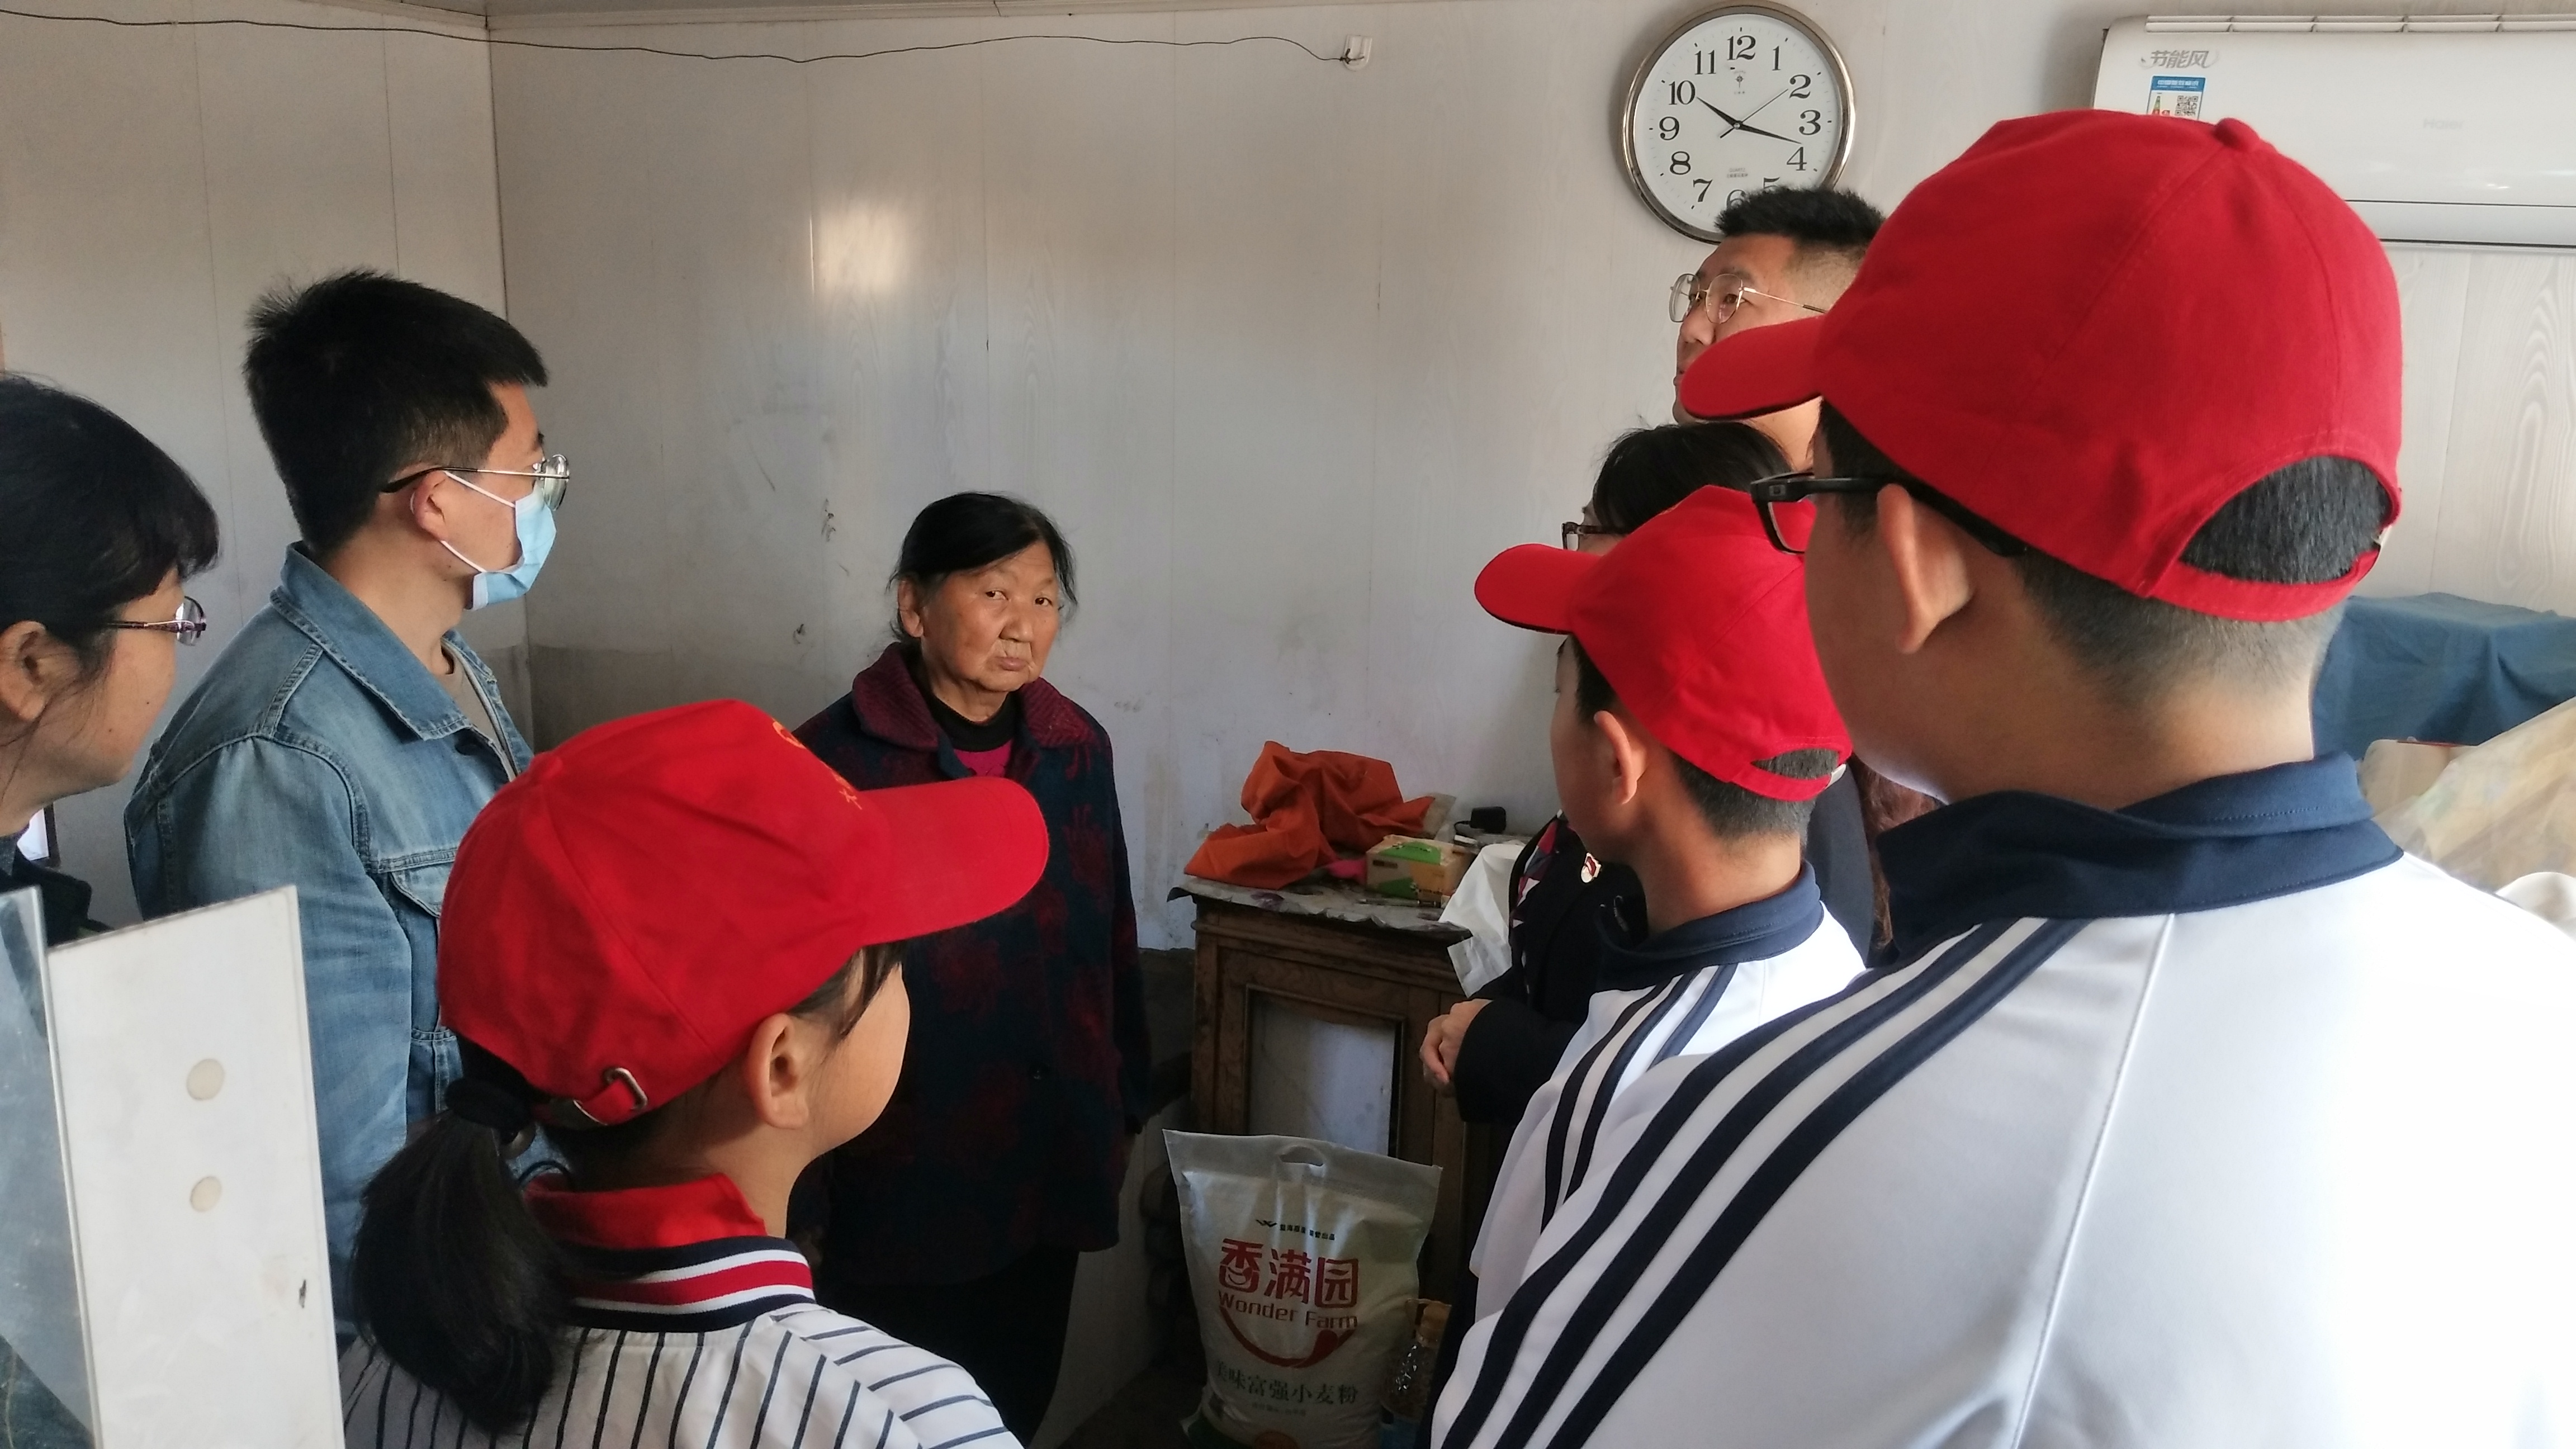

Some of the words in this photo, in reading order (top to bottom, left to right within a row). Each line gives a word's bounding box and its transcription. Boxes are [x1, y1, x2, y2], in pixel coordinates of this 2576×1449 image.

[1727, 35, 1756, 61] 12
[1772, 46, 1781, 71] 1
[2151, 50, 2209, 69] 节能风
[1694, 50, 1716, 75] 11
[1668, 80, 1696, 105] 10
[1789, 74, 1811, 99] 2
[1659, 117, 1680, 140] 9
[1798, 110, 1821, 135] 3
[2423, 117, 2464, 130] Haier
[1669, 151, 1691, 175] 8
[1786, 146, 1807, 171] 4
[1693, 178, 1713, 202] 7
[1219, 1238, 1359, 1309] 香满园
[1218, 1291, 1296, 1323] Wonder
[1305, 1310, 1358, 1330] Farm
